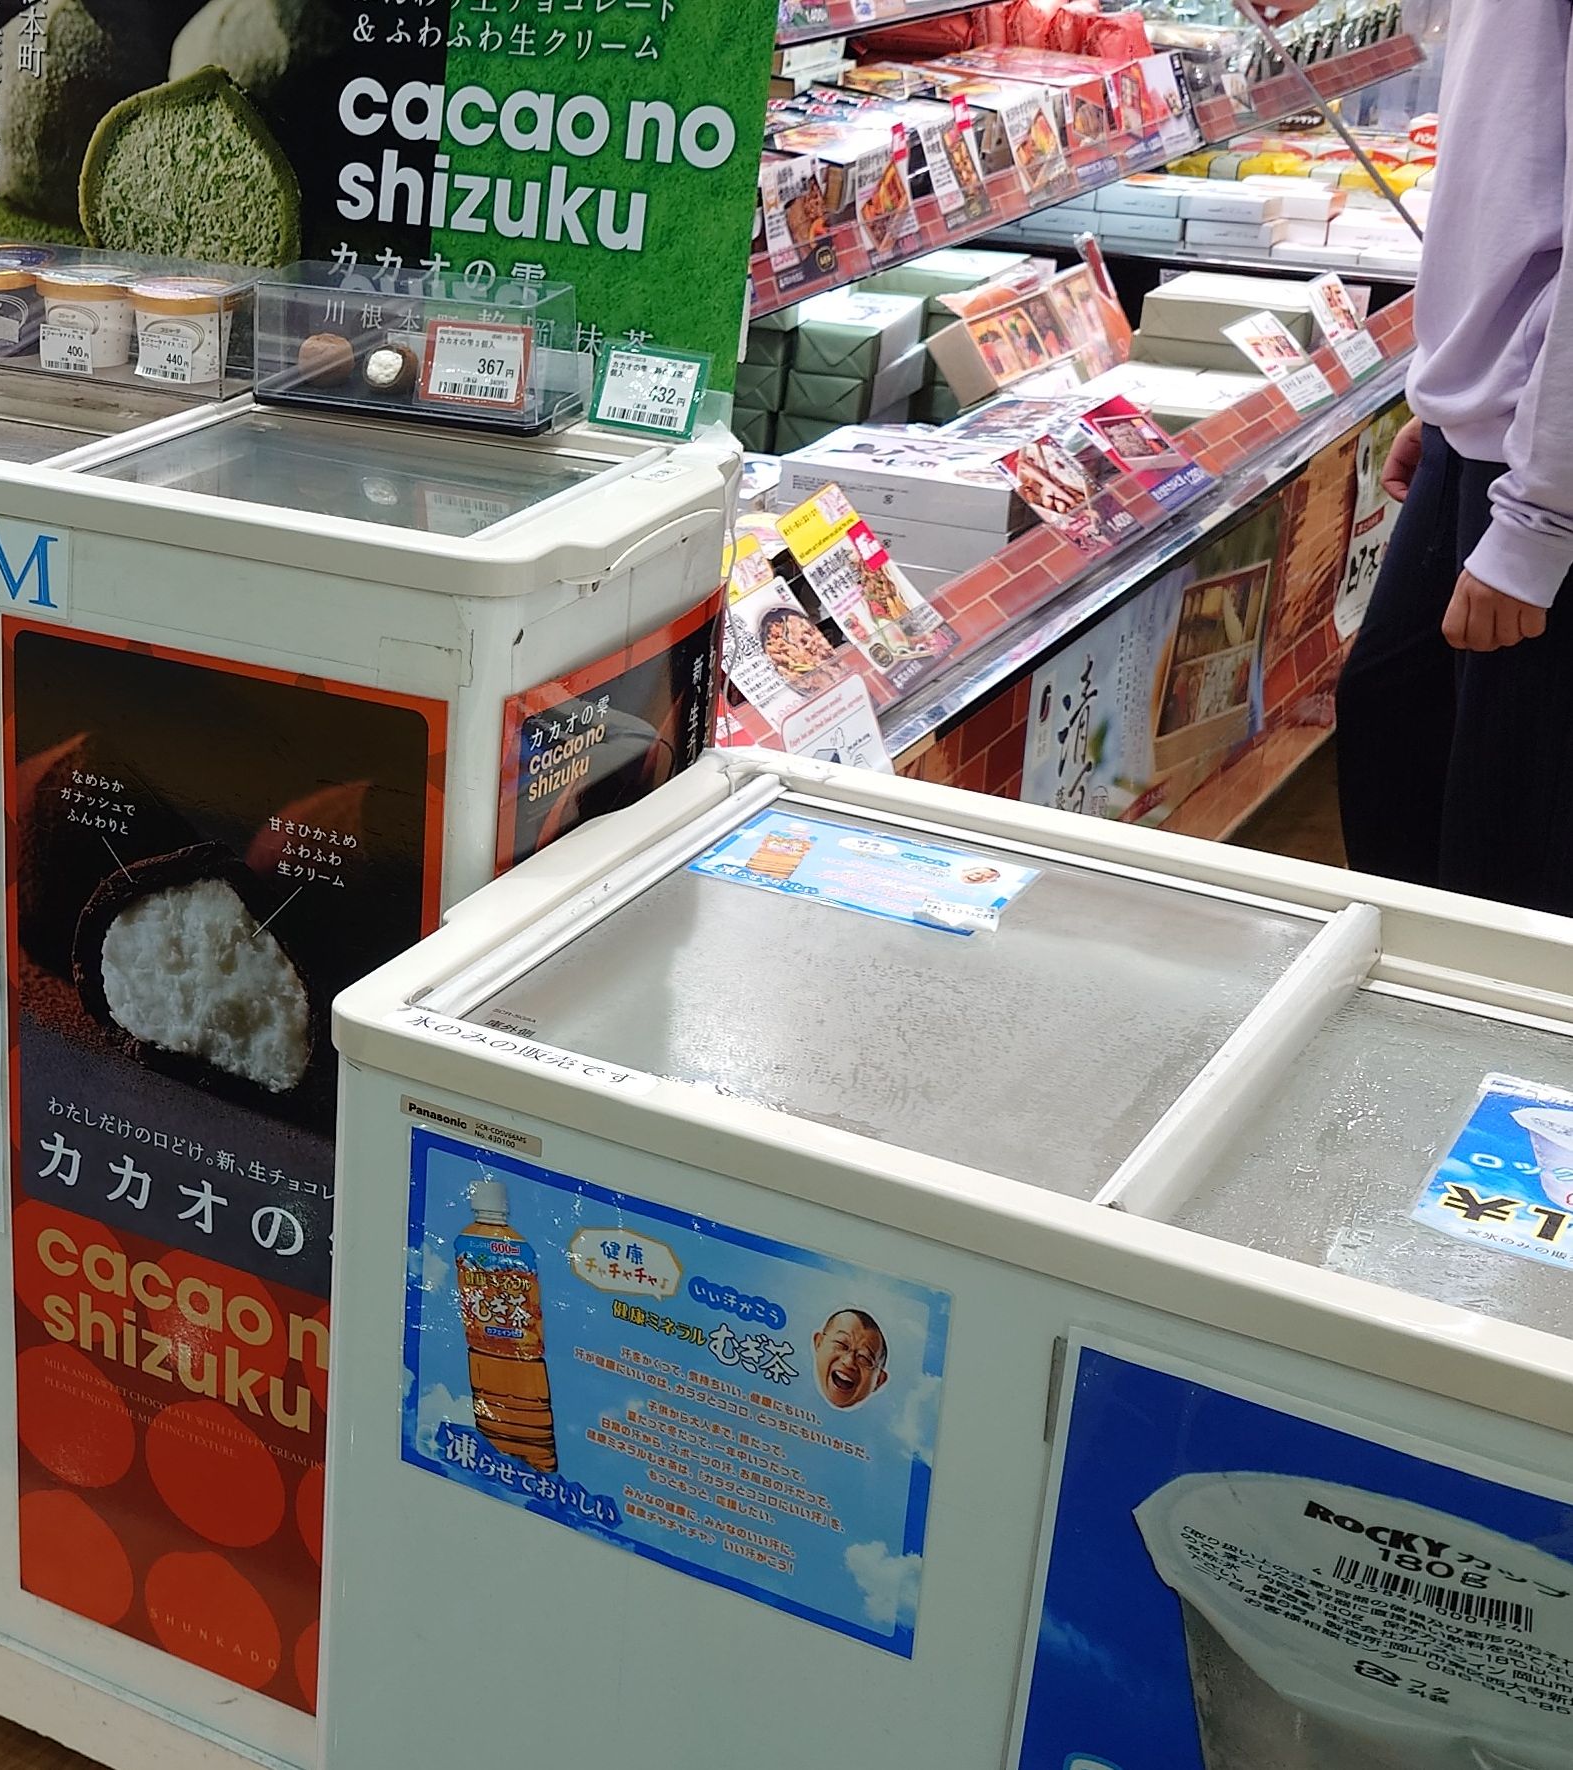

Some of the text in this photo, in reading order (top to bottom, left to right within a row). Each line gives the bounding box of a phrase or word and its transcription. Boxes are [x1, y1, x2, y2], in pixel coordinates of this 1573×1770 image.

[18, 0, 48, 78] 本町
[386, 21, 660, 61] ふわふわ生クリーム
[338, 77, 737, 169] cacao no
[336, 149, 648, 253] shizuku
[477, 358, 514, 379] 367円
[529, 694, 611, 751] カカオの雫
[529, 723, 607, 775] cacao no
[60, 787, 137, 818] ガナッシュで
[71, 769, 125, 793] なめらか
[528, 755, 591, 802] shizuku
[67, 808, 130, 836] ふんわりと
[269, 815, 358, 849] 甘さひかえめ
[277, 859, 345, 888] 生クリーム
[281, 840, 342, 867] ふわふわ
[408, 1102, 468, 1130] Panasonic
[38, 1131, 335, 1257] カカオの
[600, 1240, 644, 1265] 健康
[37, 1228, 331, 1372] cacao n
[693, 1283, 781, 1325] いい汗かこう
[42, 1291, 312, 1434] shizuku
[612, 1298, 800, 1386] 健康ミネラル むぎ茶
[129, 1390, 191, 1424] CHOCOLATE
[267, 1443, 309, 1468] CREAM
[135, 1412, 185, 1439] MELTING
[445, 1428, 615, 1522] 凍らせておいしい
[1304, 1500, 1452, 1559] ROCKY
[148, 1606, 278, 1671] SHUNKADO
